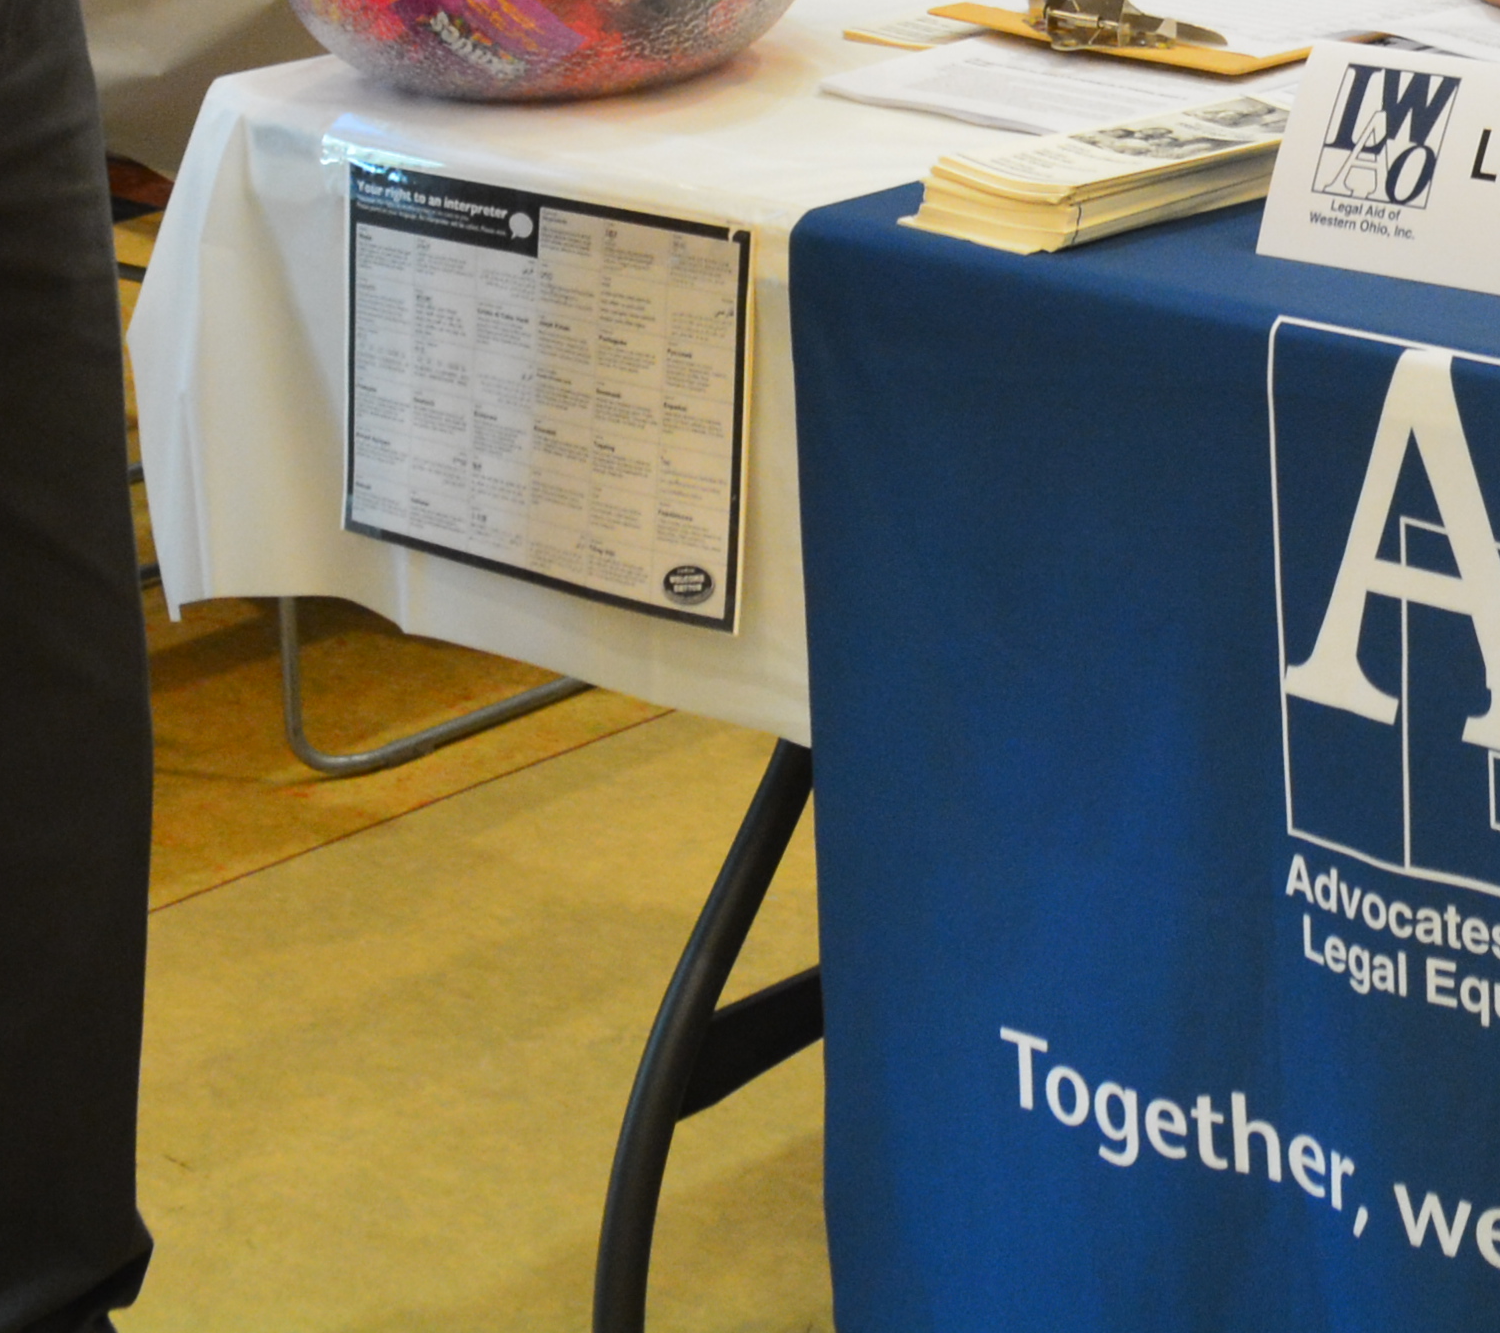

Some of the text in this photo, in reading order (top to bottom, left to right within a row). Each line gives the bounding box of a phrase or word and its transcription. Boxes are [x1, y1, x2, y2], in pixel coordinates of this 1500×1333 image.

[357, 180, 383, 196] Your
[385, 185, 412, 202] right
[414, 192, 426, 204] to
[428, 196, 442, 207] an
[444, 197, 508, 219] interpreter
[1330, 199, 1402, 221] Legal Aid of
[1309, 211, 1415, 240] Western Ohio, Inc.
[1300, 915, 1409, 998] Legal
[998, 1025, 1372, 1239] Together,
